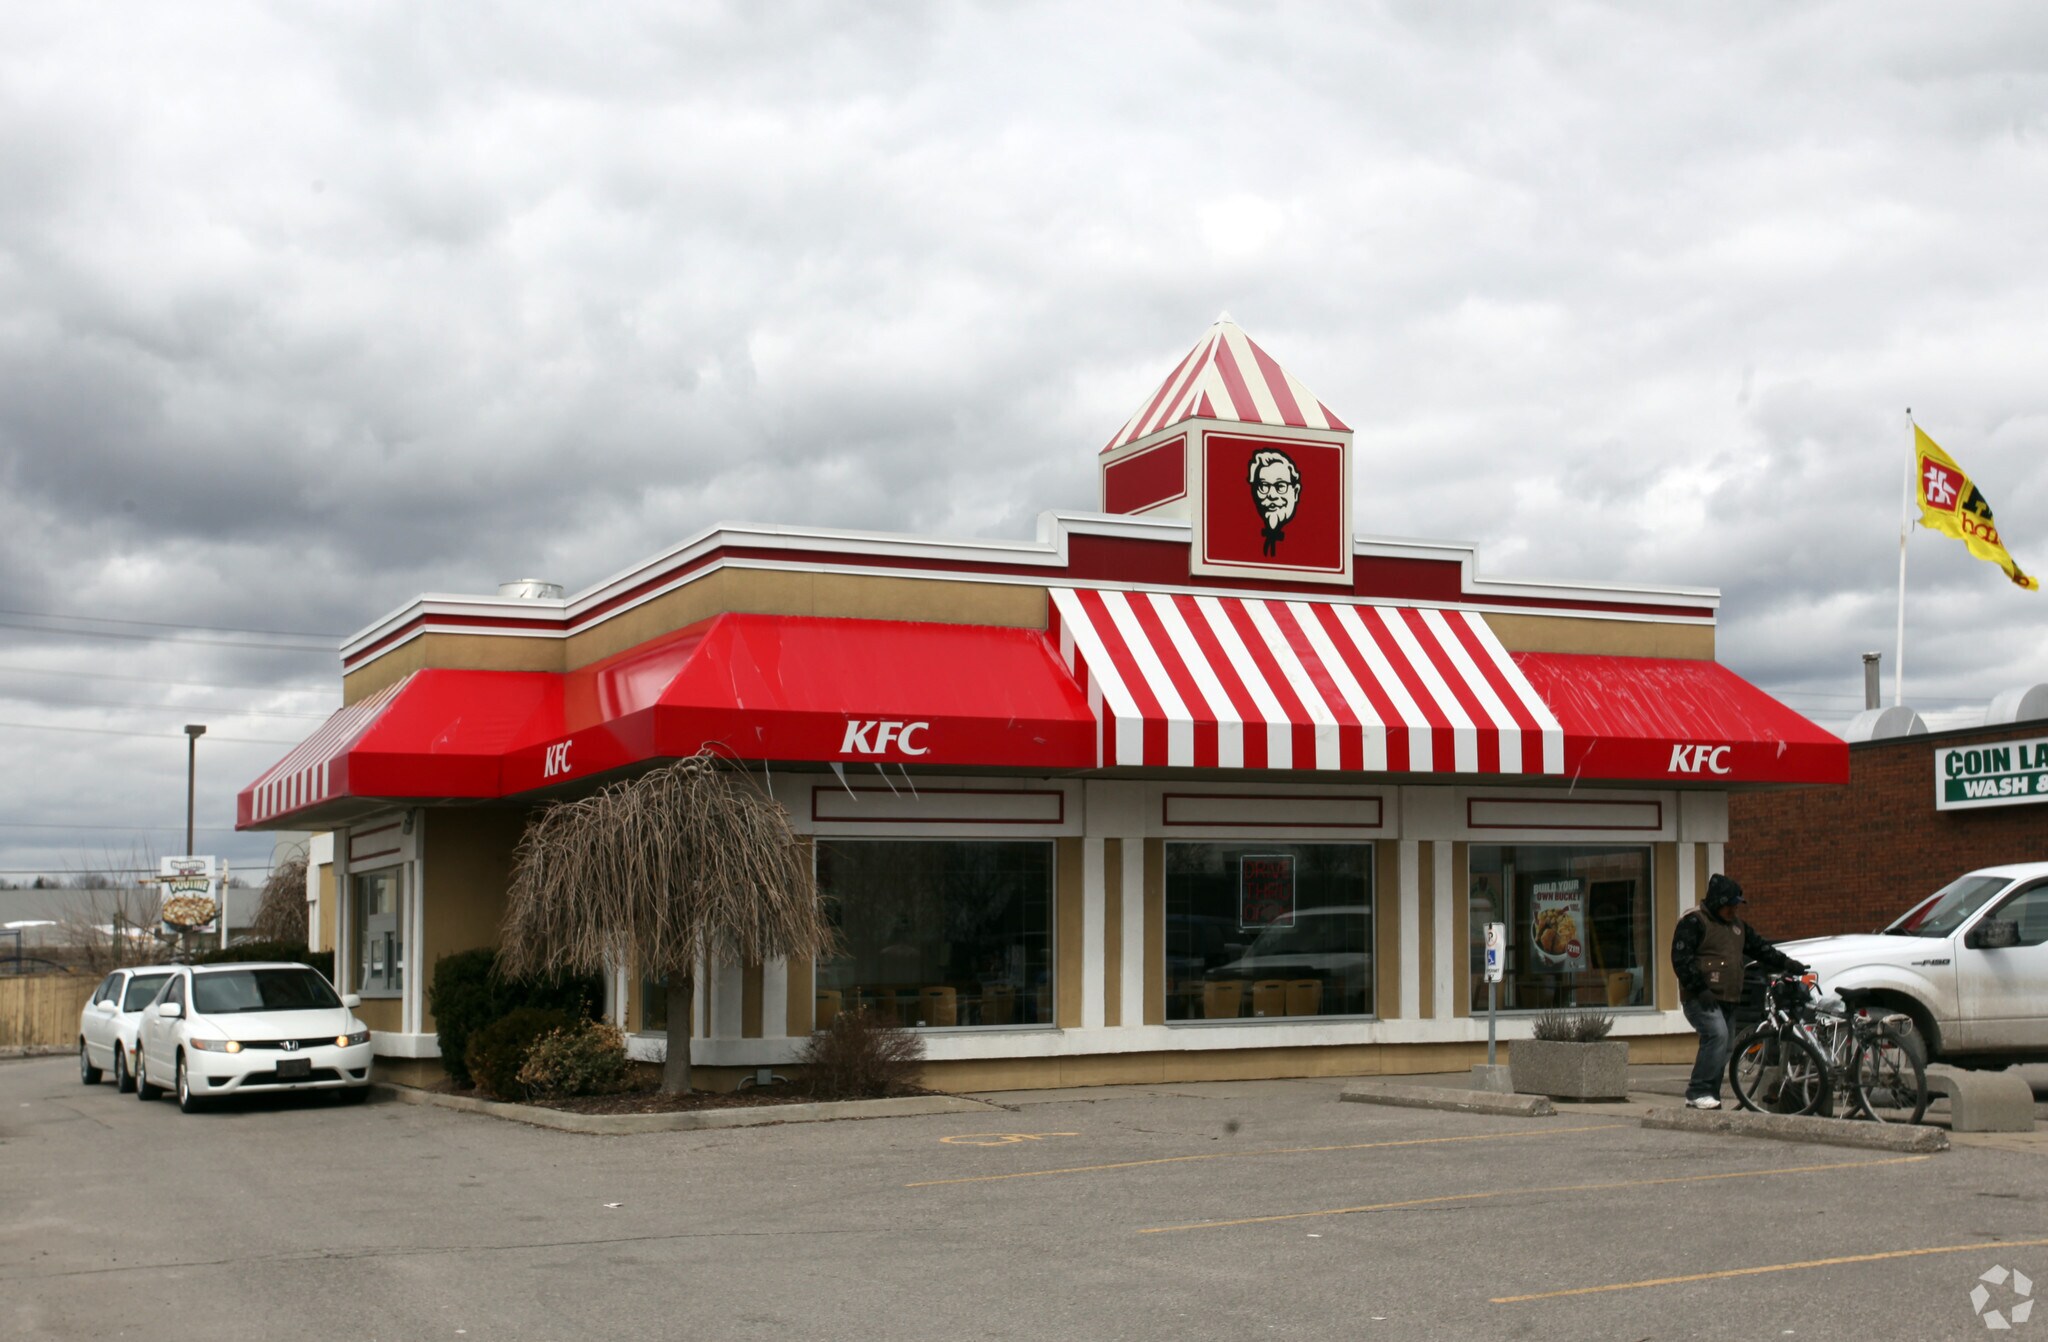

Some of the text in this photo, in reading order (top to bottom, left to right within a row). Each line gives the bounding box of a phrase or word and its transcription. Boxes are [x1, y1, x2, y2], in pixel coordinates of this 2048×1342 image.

[839, 720, 929, 755] KFC
[544, 739, 573, 778] KFC
[1668, 744, 1731, 774] KFC
[1963, 776, 2029, 798] WASH
[1246, 882, 1292, 901] THRU
[1533, 880, 1580, 895] BUILD YOUR
[1536, 892, 1581, 901] OWN BUCKET
